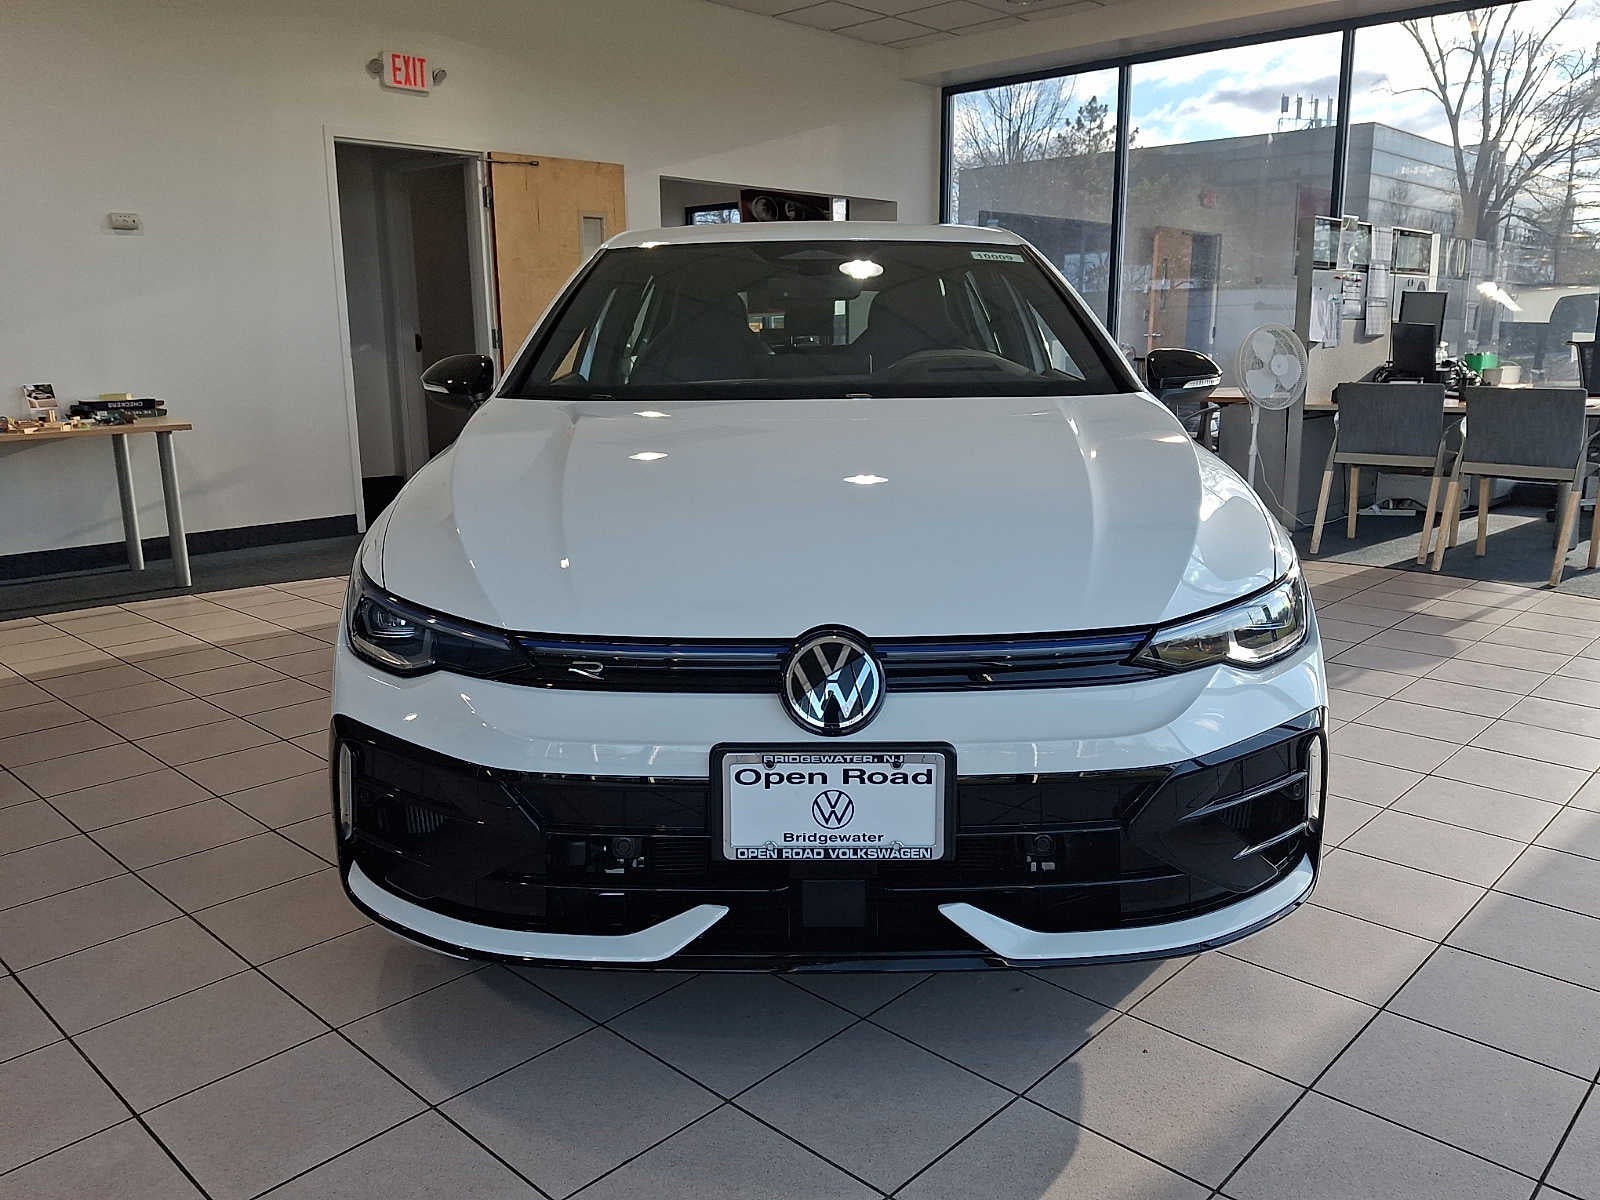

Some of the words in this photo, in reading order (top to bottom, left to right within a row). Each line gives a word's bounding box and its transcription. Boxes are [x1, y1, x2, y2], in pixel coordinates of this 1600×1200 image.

[391, 53, 426, 88] EXIT
[107, 401, 144, 409] CHECKERS
[734, 768, 828, 789] Open
[842, 768, 933, 785] Road
[783, 832, 884, 845] Bridgewater
[737, 848, 780, 859] OPEN
[783, 848, 824, 859] ROAD
[828, 848, 931, 859] VOLKSWAGEN
